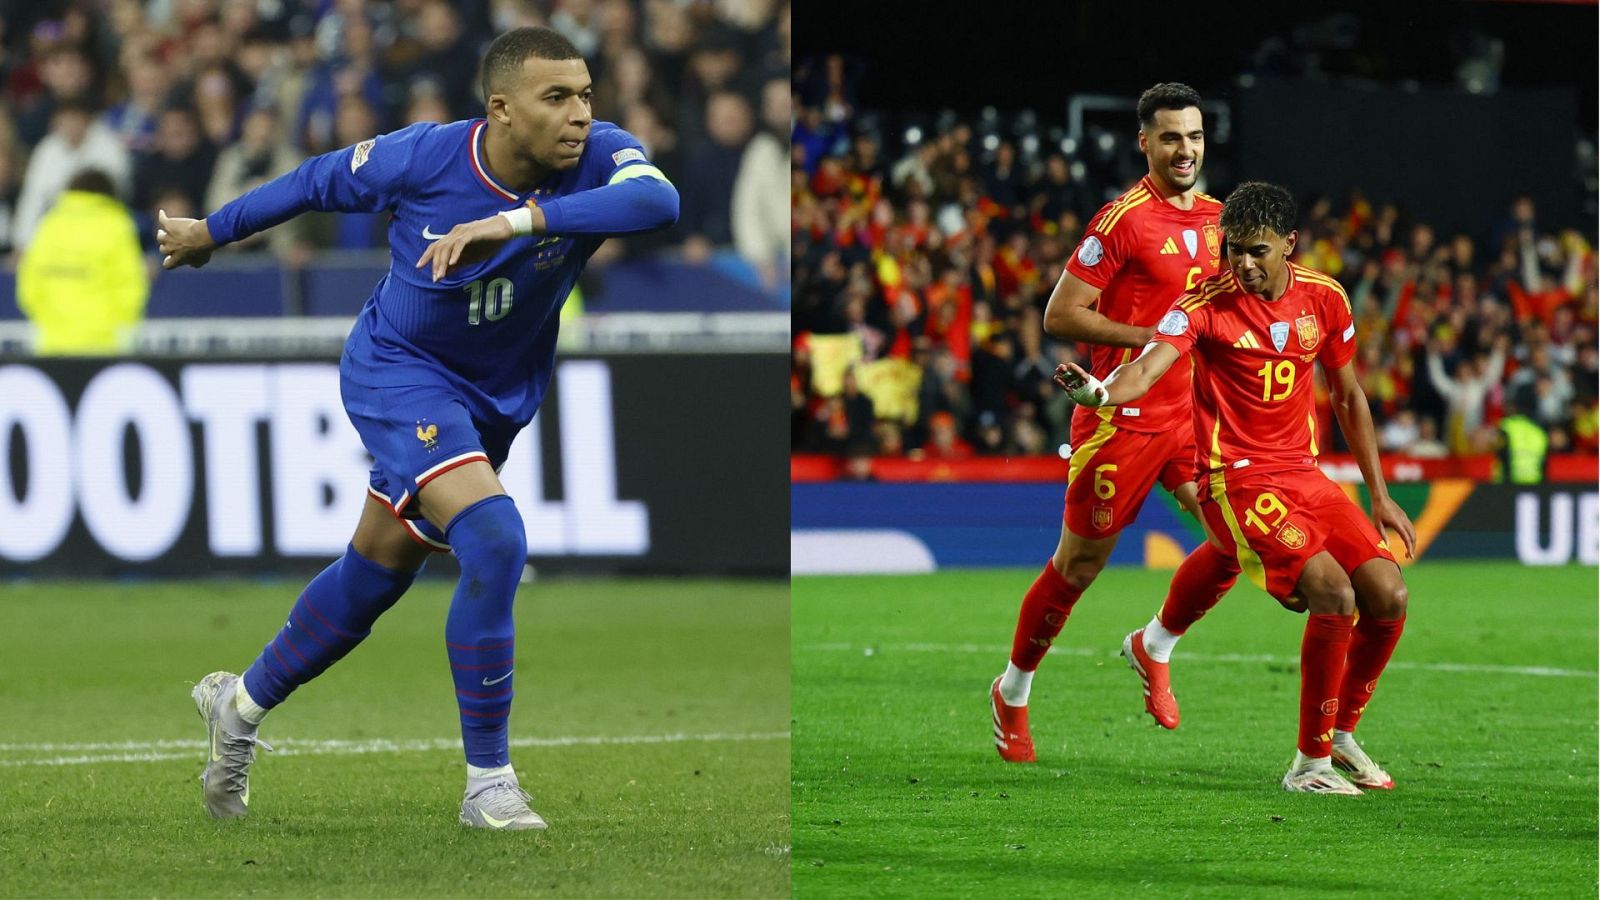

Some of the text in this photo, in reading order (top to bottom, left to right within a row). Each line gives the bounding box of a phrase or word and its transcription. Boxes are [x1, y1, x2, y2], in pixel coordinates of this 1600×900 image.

[463, 277, 514, 326] 10
[1257, 359, 1296, 402] 19
[1094, 463, 1118, 500] 6
[1244, 492, 1288, 536] 19
